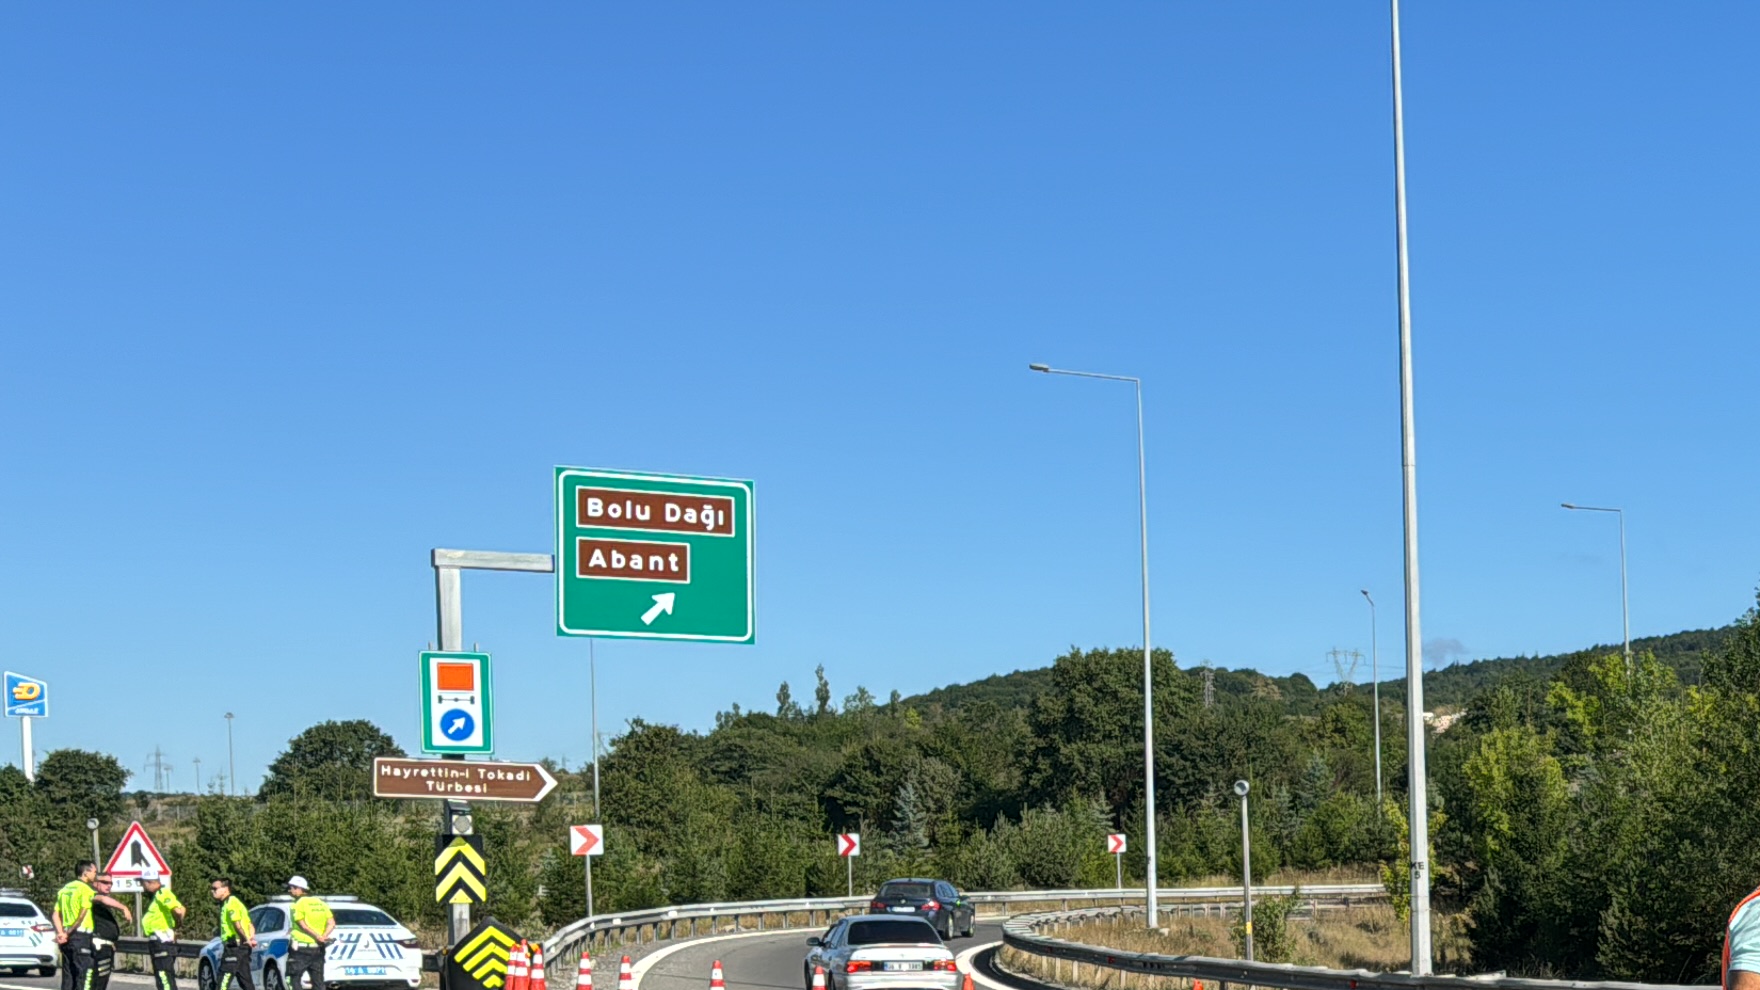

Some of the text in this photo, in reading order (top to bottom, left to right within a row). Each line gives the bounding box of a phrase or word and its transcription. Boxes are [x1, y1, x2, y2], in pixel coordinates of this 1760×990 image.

[587, 497, 725, 531] Bolu Dağı
[588, 548, 680, 572] Abant
[425, 780, 488, 794] Türbesi
